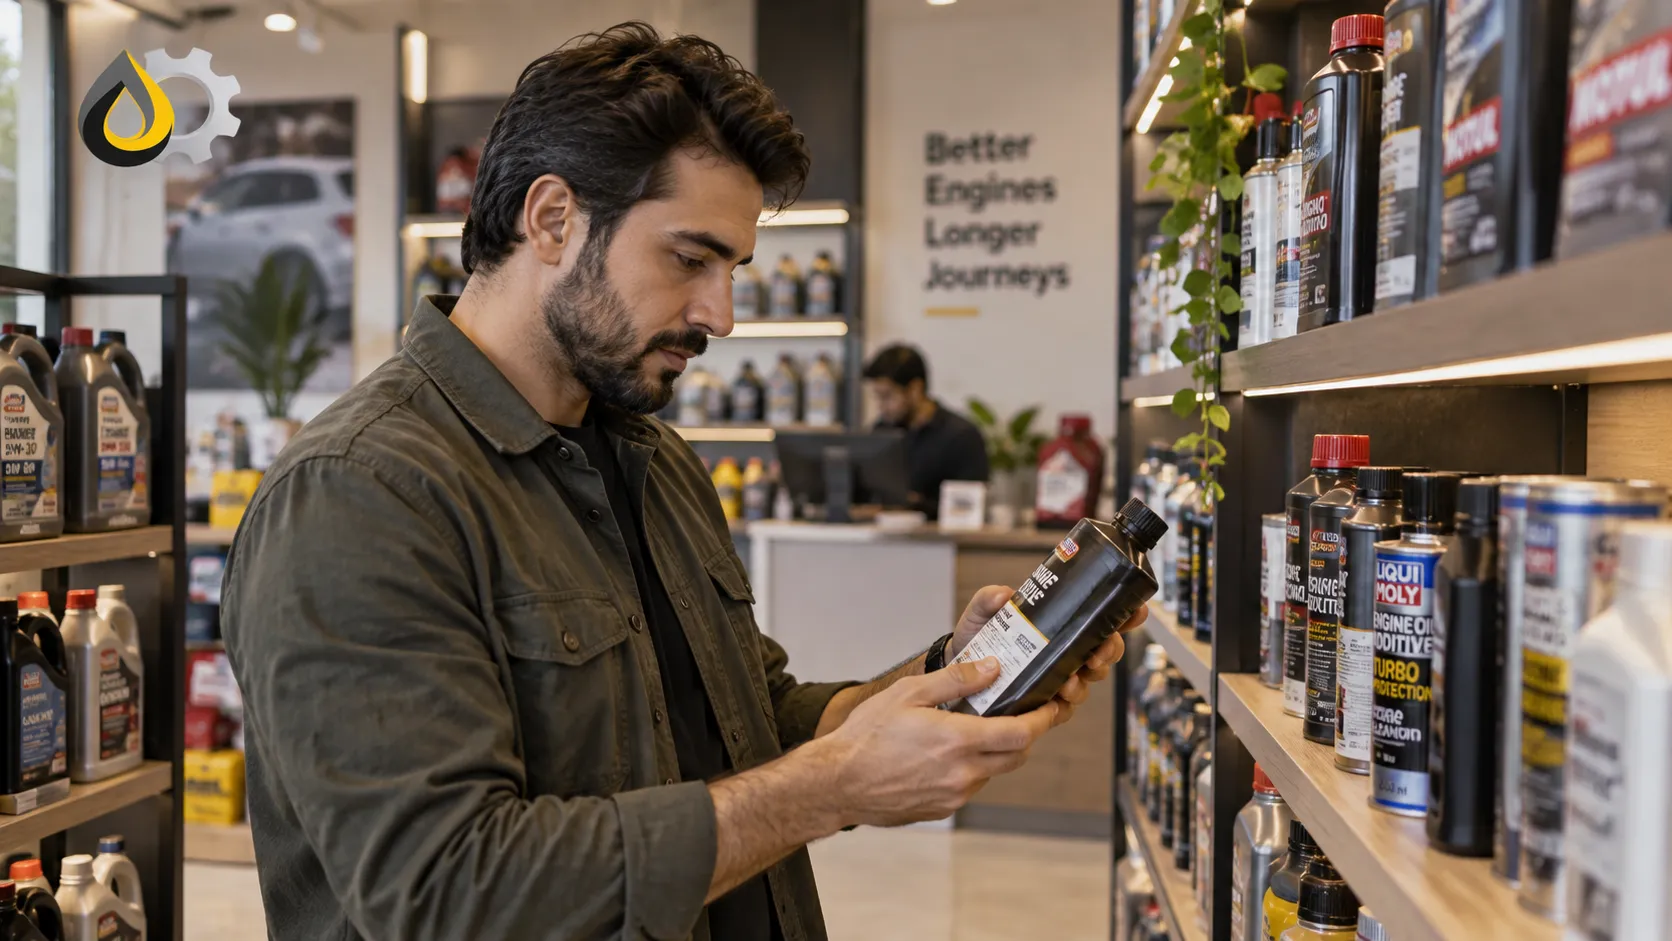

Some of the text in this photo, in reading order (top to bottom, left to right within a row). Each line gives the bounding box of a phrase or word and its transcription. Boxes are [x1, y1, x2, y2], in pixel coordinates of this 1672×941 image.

[925, 132, 1034, 165] Better
[925, 172, 1057, 213] Engines
[925, 217, 1041, 254] Longer
[923, 260, 1069, 297] Journeys
[1377, 562, 1419, 583] LIQUI
[1376, 582, 1419, 605] MOLY
[1374, 611, 1414, 635] ENGINE
[1374, 631, 1433, 655] DDITIVE
[1374, 656, 1420, 683] TURBO
